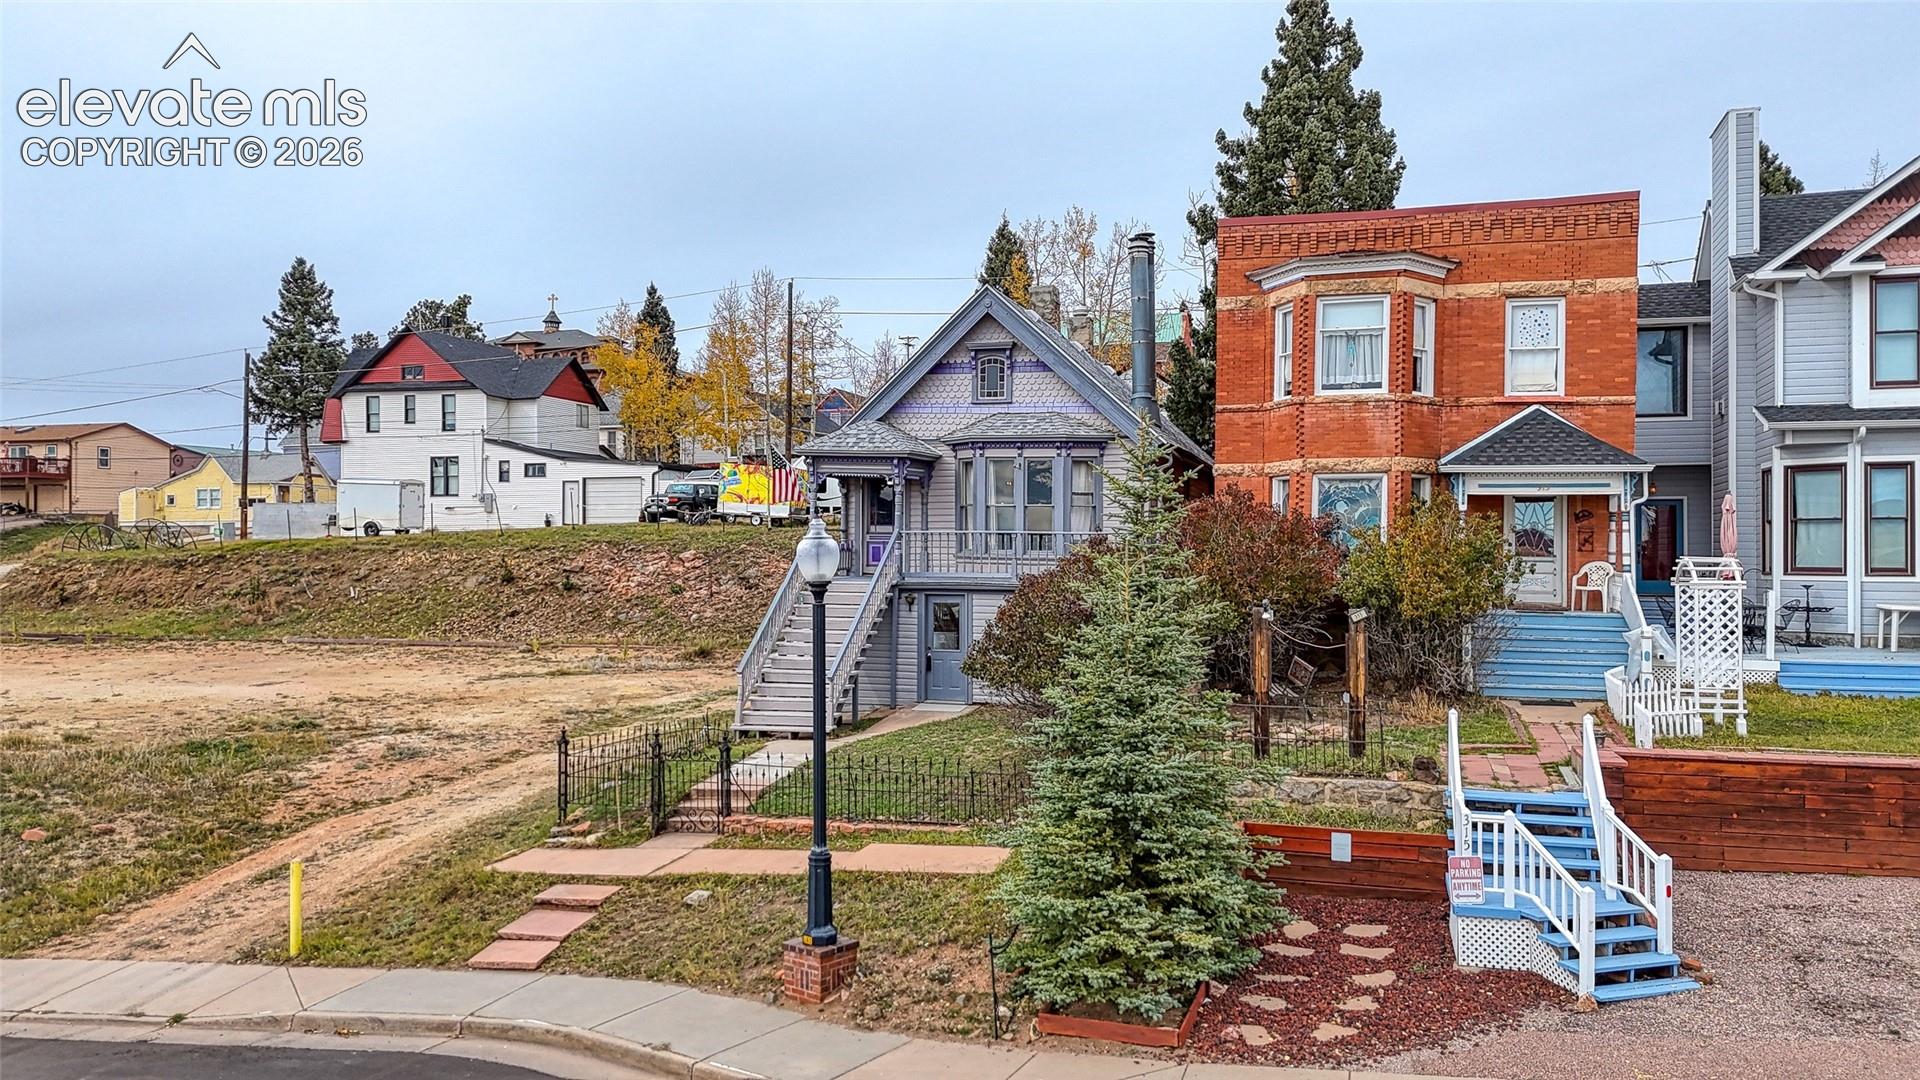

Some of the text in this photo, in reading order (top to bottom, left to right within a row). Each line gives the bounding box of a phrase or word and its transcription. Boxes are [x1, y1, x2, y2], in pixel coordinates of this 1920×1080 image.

[1460, 859, 1471, 868] NO
[1450, 869, 1482, 878] PARKING
[1453, 881, 1482, 891] ANYTIME
